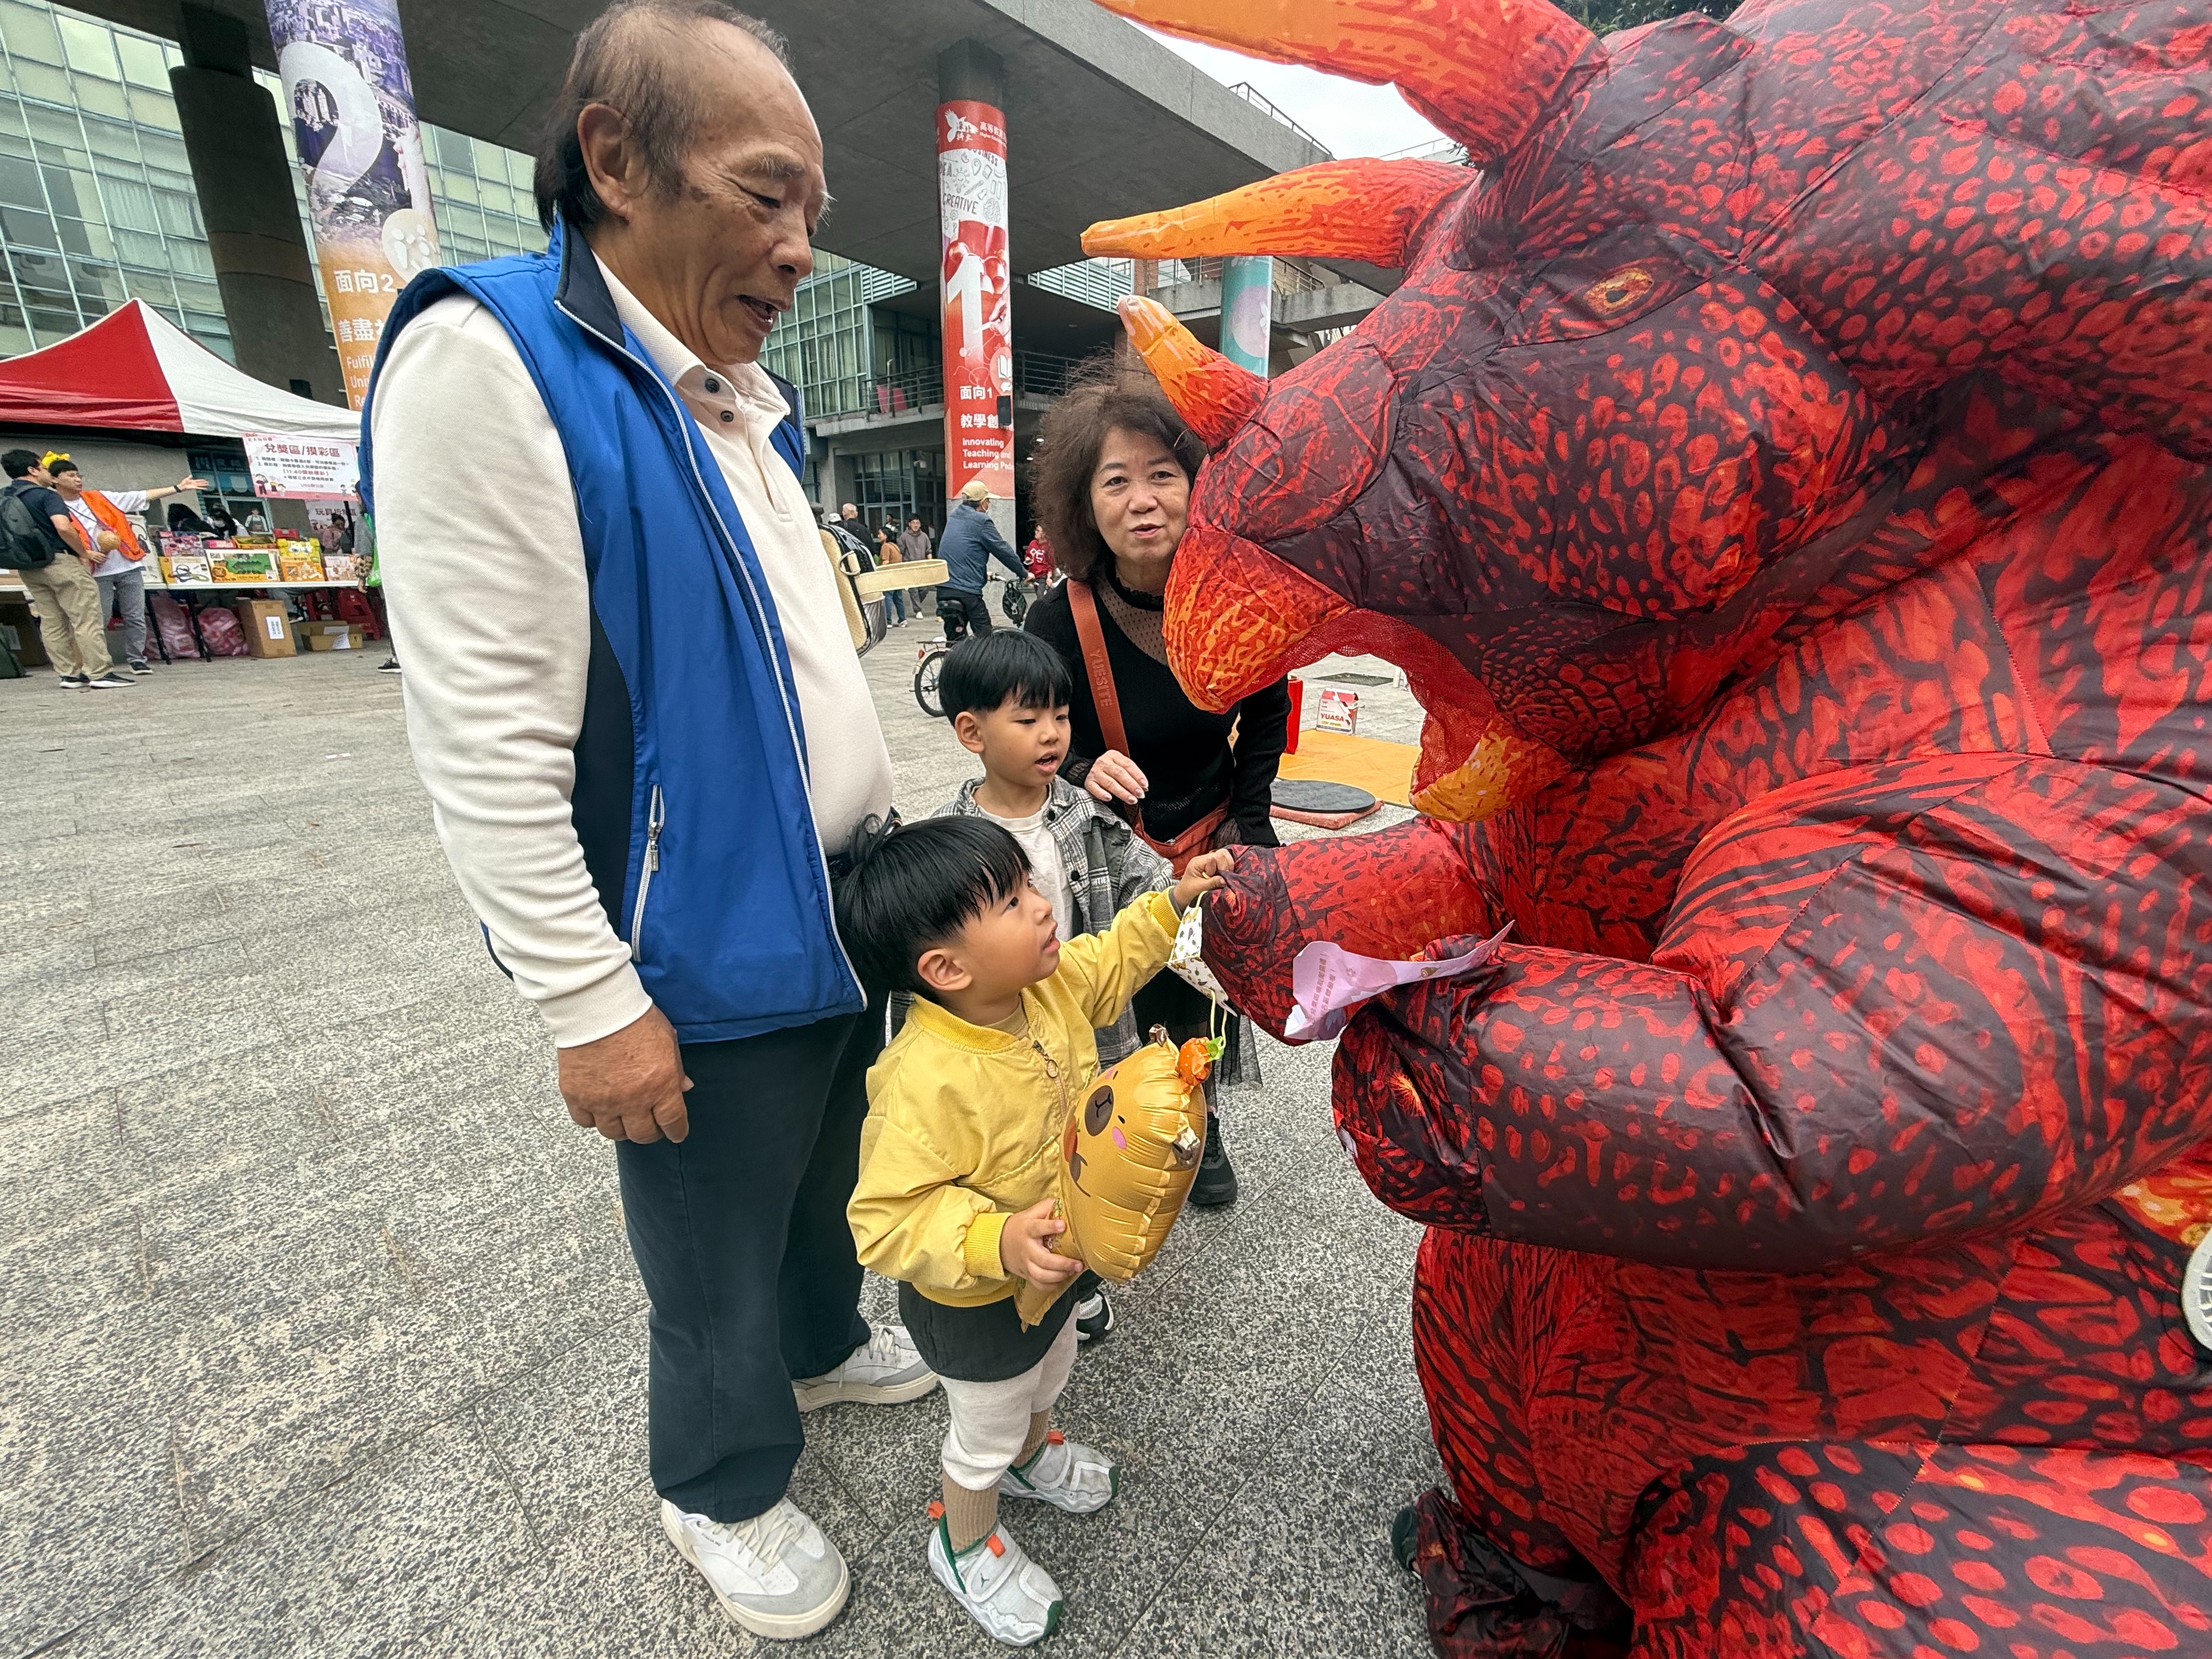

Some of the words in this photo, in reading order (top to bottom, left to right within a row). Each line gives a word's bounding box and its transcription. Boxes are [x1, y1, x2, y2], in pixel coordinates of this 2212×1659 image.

[943, 193, 979, 215] CREATIVE
[333, 269, 396, 294] 面向2
[960, 385, 992, 400] 面向1
[962, 438, 1004, 449] Innovating
[962, 449, 999, 460] Teaching
[963, 460, 998, 471] Learning
[1089, 650, 1112, 707] YUESITE
[1321, 713, 1344, 721] YUASA
